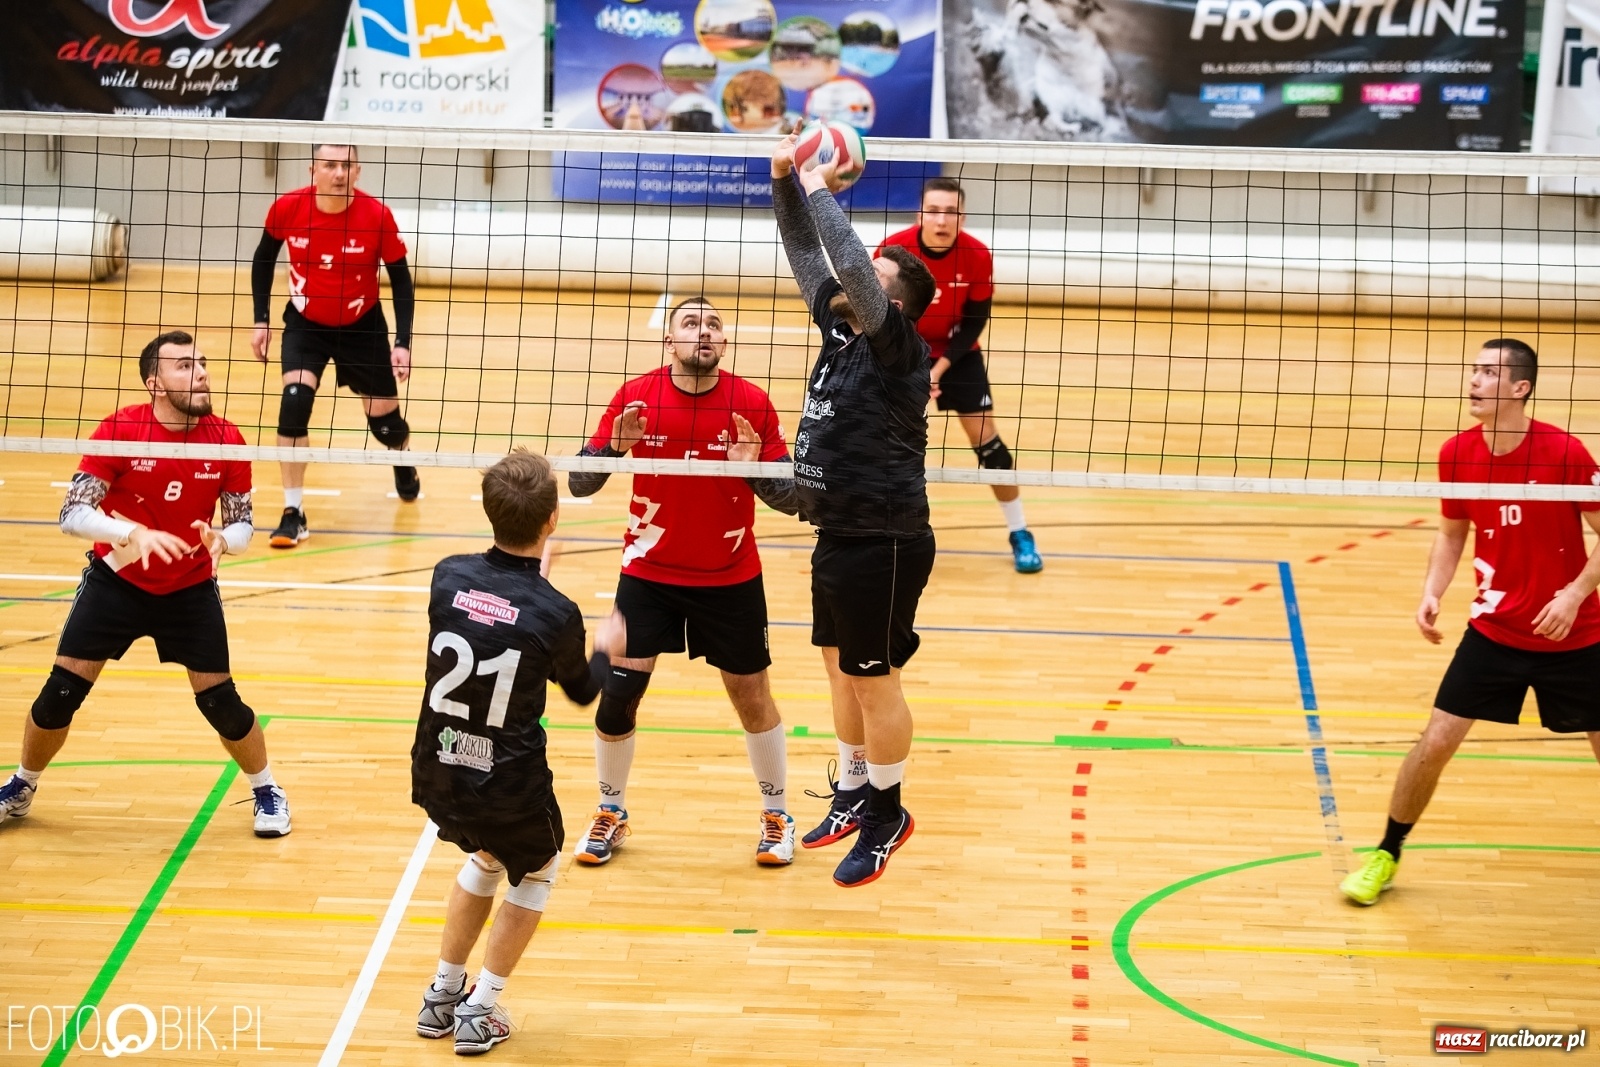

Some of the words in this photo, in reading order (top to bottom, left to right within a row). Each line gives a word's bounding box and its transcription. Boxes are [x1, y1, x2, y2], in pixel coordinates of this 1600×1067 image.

[57, 34, 163, 70] alpha
[166, 40, 281, 77] spirit
[101, 69, 140, 88] wild
[142, 74, 177, 92] and
[180, 72, 239, 96] perfect
[380, 66, 509, 91] raciborski
[1443, 85, 1487, 101] SPRAY
[367, 99, 423, 113] oaza
[319, 254, 334, 270] 3
[813, 363, 829, 390] 1
[164, 481, 183, 501] 8
[1499, 505, 1522, 527] 10
[457, 595, 513, 621] PIWIARNIA
[429, 631, 522, 728] 21
